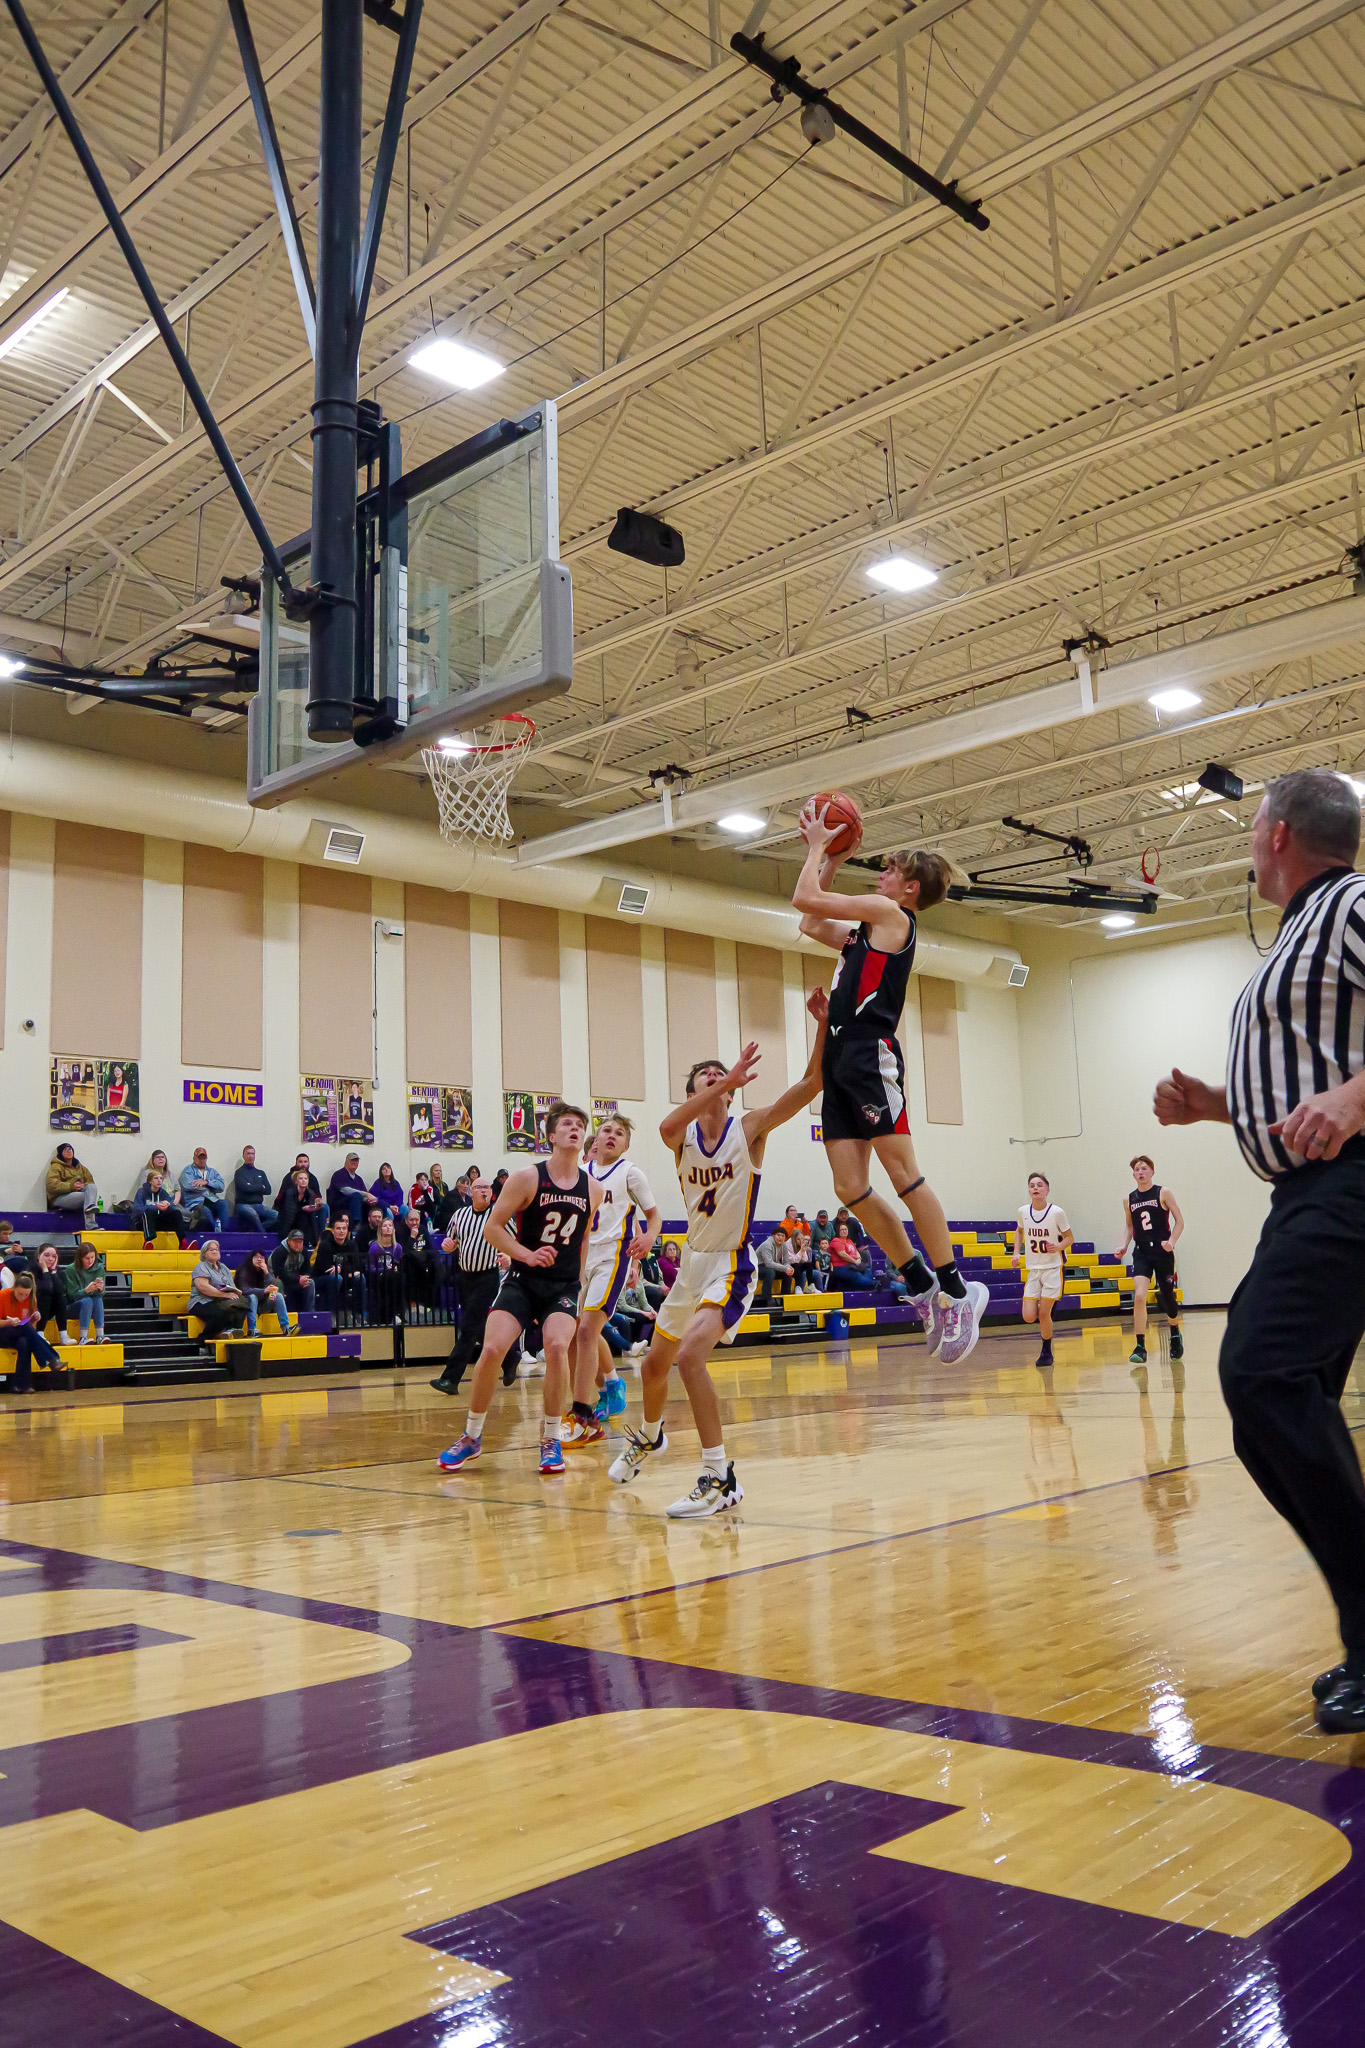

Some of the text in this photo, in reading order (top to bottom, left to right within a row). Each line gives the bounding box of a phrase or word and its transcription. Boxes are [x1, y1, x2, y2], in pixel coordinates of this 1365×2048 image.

[189, 1082, 257, 1105] HOME
[688, 1162, 734, 1188] JUDA
[540, 1192, 587, 1213] CHALLENGERS
[697, 1187, 718, 1219] 4
[540, 1211, 579, 1246] 24
[1140, 1210, 1153, 1231] 2
[1028, 1228, 1050, 1238] JUDA
[1030, 1240, 1048, 1254] 20
